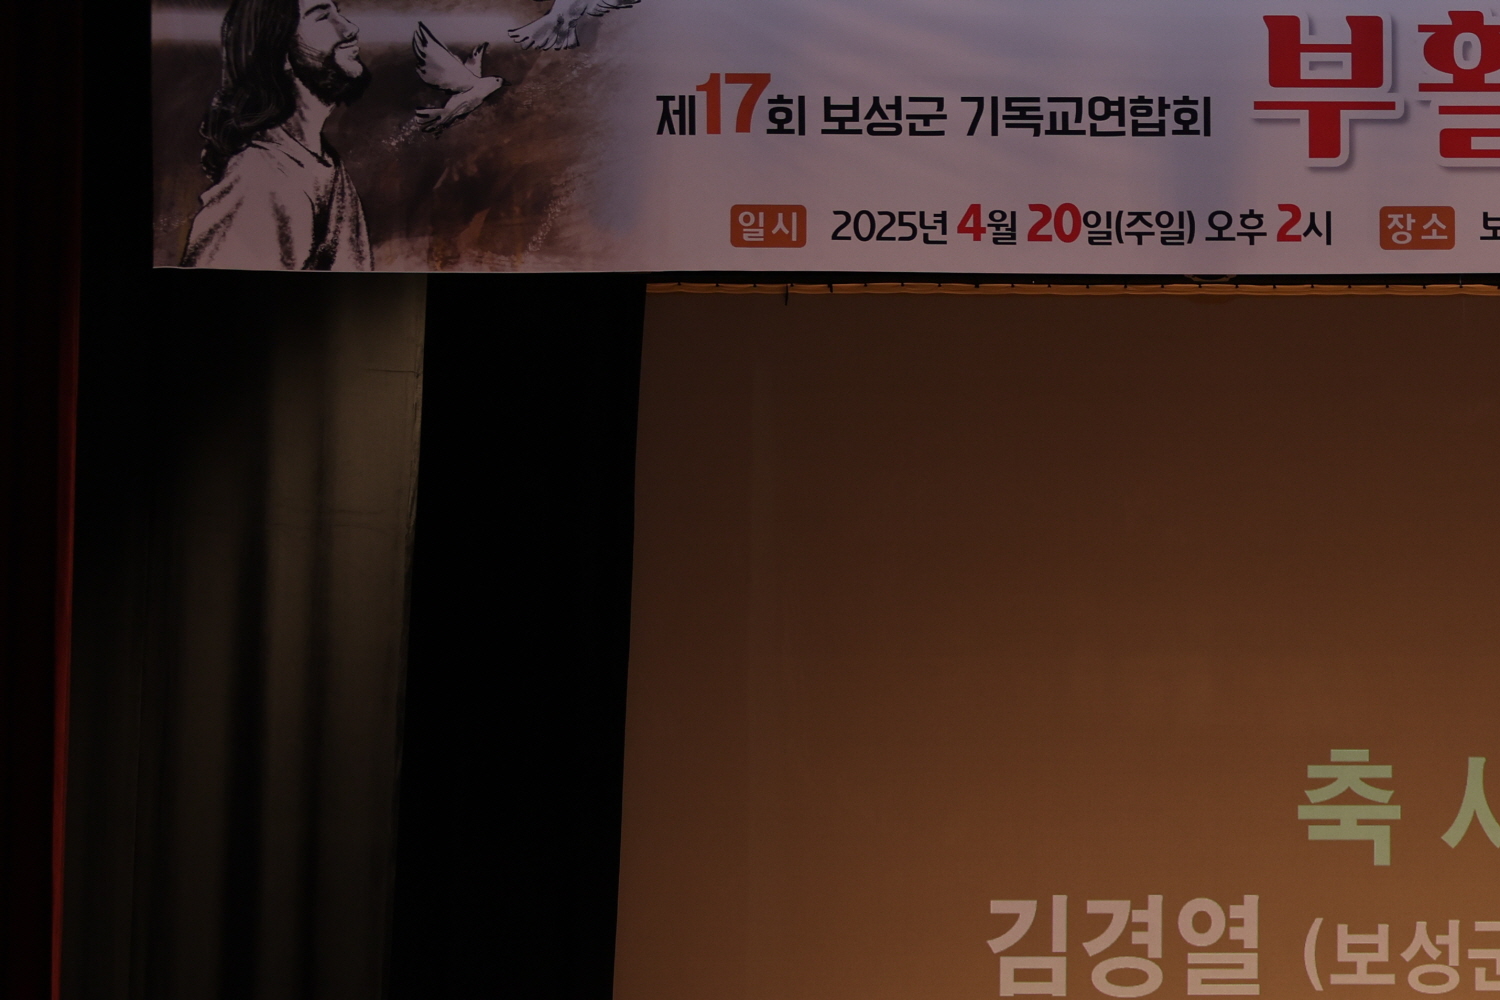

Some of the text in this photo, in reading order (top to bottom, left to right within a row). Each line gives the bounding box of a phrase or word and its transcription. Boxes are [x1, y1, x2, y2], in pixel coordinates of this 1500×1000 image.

[656, 73, 1212, 138] 제17회 보성군 기독교연합회
[738, 211, 798, 242] 일시
[831, 202, 1333, 246] 2025년 4월 20일(주일) 오후 2시
[1386, 212, 1449, 245] 장소
[986, 894, 1261, 999] 김경열
